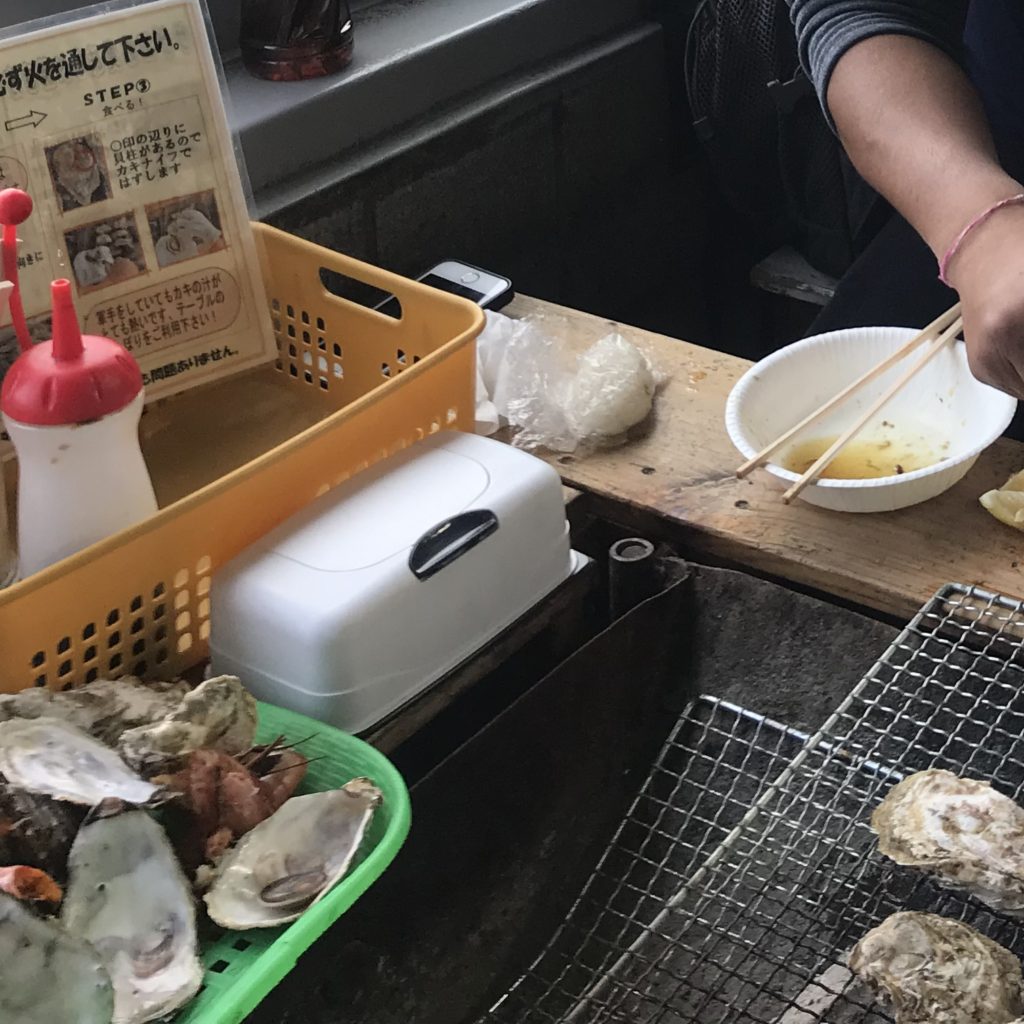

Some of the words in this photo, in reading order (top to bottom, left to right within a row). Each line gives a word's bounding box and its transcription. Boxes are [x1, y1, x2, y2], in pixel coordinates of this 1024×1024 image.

[0, 27, 180, 97] ず火を通して下さい。
[113, 132, 201, 166] 貝柱があるので
[117, 148, 192, 176] カキナイフで
[119, 163, 181, 189] はずします
